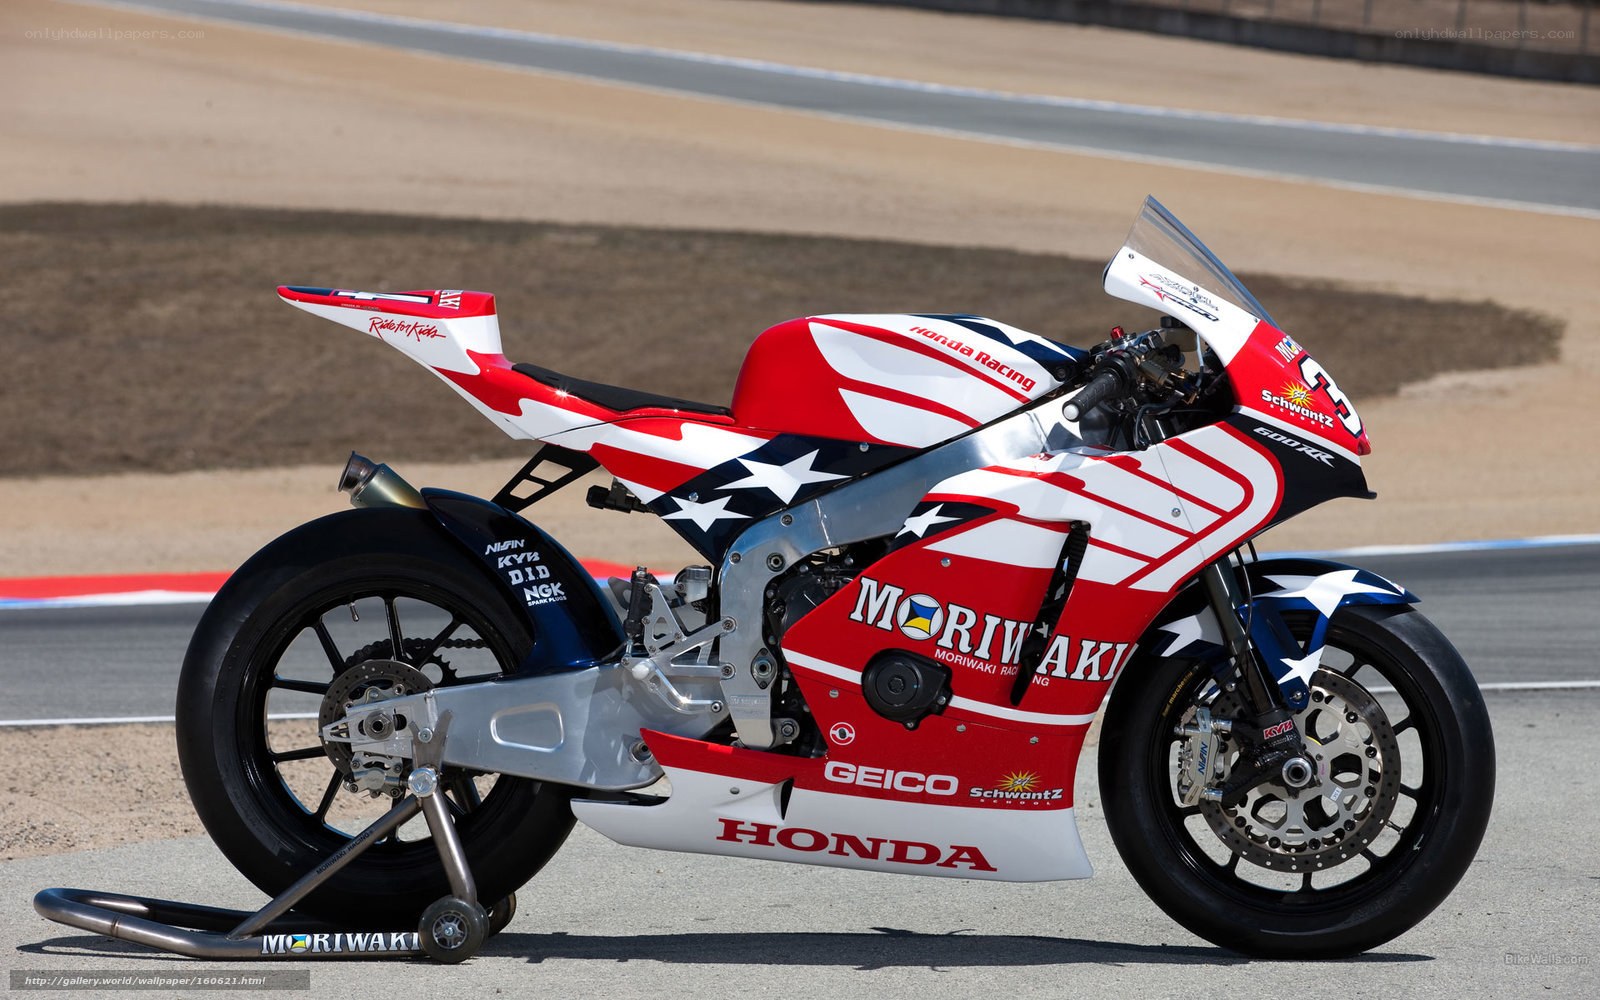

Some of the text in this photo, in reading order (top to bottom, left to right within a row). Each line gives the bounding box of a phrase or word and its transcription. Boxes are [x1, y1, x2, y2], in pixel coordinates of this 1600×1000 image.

[369, 316, 446, 342] Ride for Kids
[909, 326, 1037, 393] Honda Racing
[485, 539, 525, 555] NISSIN
[498, 551, 540, 569] KYB
[523, 582, 565, 602] NGK
[527, 595, 567, 607] SPARK PLUGS
[849, 575, 1129, 682] MORIWAKI
[934, 649, 1050, 687] MORIWAKI RACNG
[1263, 719, 1294, 740] KYB
[824, 760, 959, 796] GEICO
[716, 817, 998, 873] HONDA
[316, 849, 347, 875] MORIWAKI
[261, 932, 420, 954] MORIWAKI
